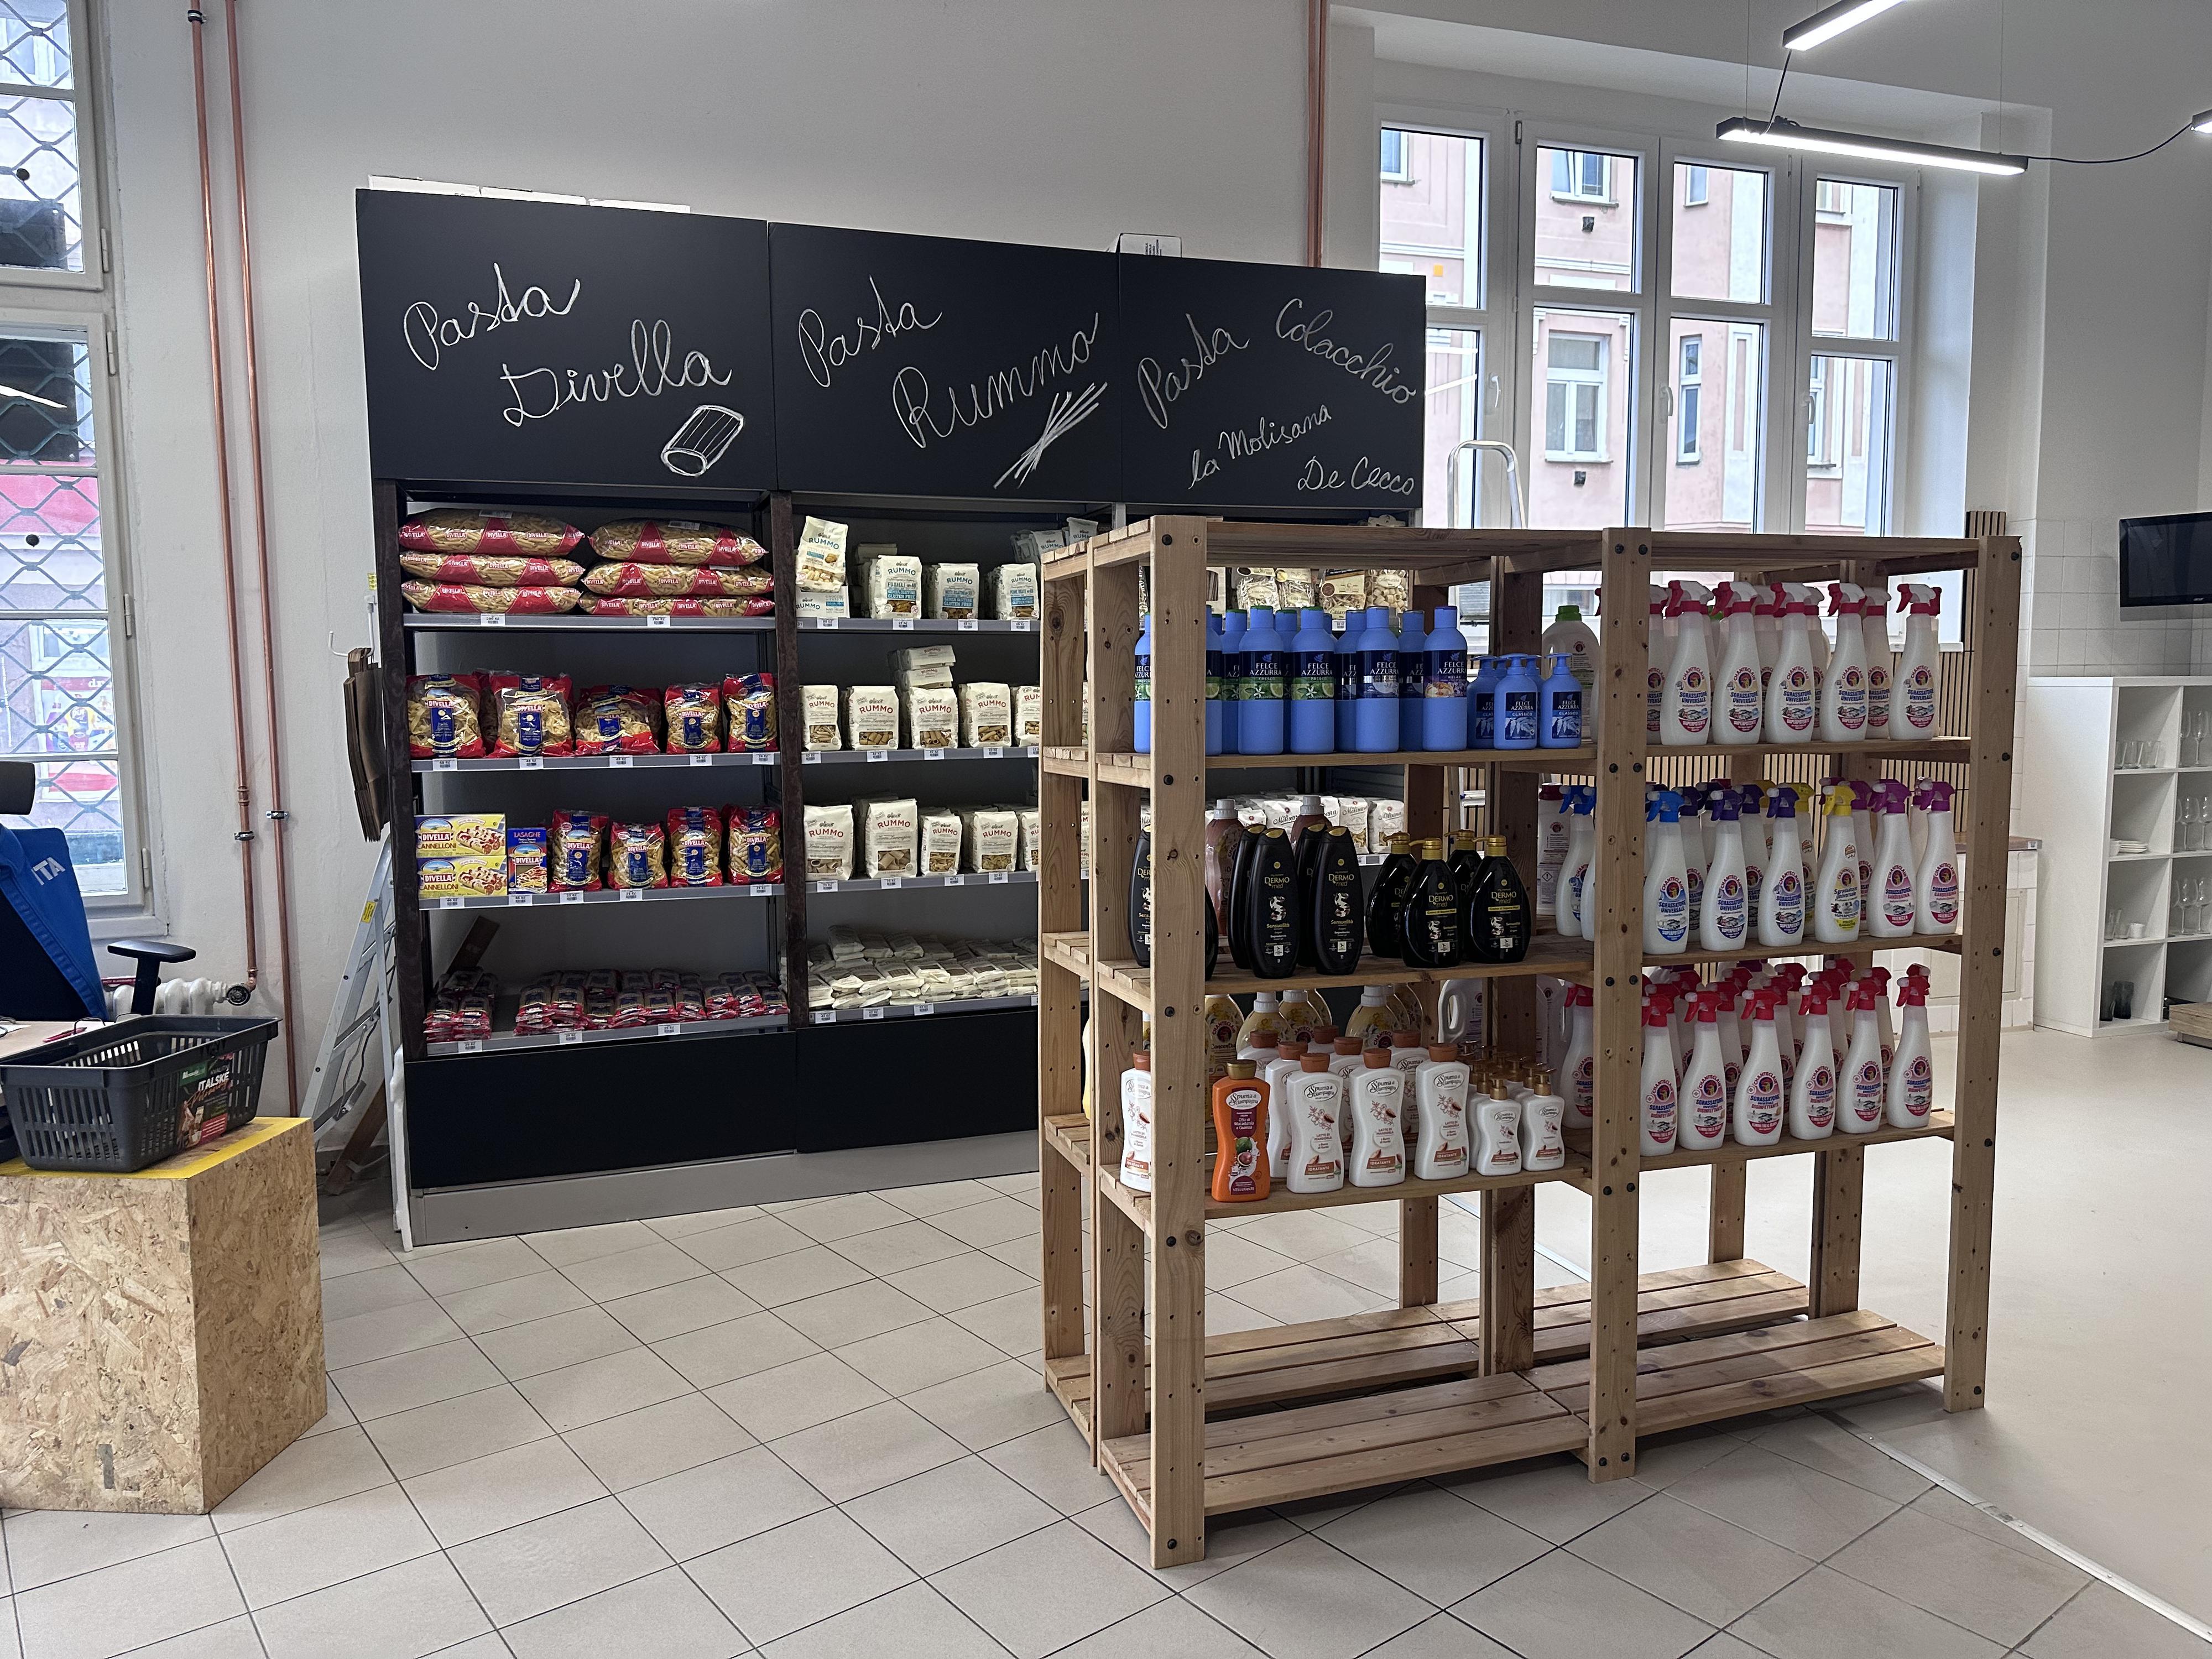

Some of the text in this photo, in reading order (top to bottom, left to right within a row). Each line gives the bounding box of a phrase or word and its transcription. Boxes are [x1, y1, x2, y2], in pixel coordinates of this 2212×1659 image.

[403, 262, 580, 371] Pasta
[799, 274, 942, 387] Pasta
[1275, 298, 1416, 404] Colacchio
[499, 319, 733, 427] Divella
[1138, 312, 1250, 429] Pasta
[893, 312, 1099, 448] Rummo
[1218, 405, 1332, 459] Molisana
[1297, 456, 1414, 495] De Cecco
[808, 538, 839, 550] RUMMO
[1683, 667, 1704, 680] CHANTECLAIR
[1733, 667, 1756, 680] CHANTECLAIR
[1787, 666, 1809, 680] CHANTECLAIR
[1841, 666, 1863, 679] CHANTECLAIR
[1911, 665, 1932, 679] CHANTECLAIR
[860, 705, 893, 714] RUMMO
[919, 705, 951, 714] RUMMO
[878, 820, 910, 829] RUMMO
[809, 829, 843, 837] RUMMO
[31, 857, 66, 885] ITA
[1888, 865, 1907, 878] CHANTECLAIR
[1934, 863, 1955, 876] CHANTECLAIR
[1662, 877, 1683, 890] CHANTECLAIR
[1721, 875, 1741, 889] CHANTECLAIR
[1779, 871, 1799, 885] CHANTECLAIR
[1212, 1021, 1235, 1035] CHANTECLAIR
[1859, 1061, 1880, 1074] CHANTECLAIR
[1910, 1056, 1929, 1070] CHANTECLAIR
[198, 1068, 229, 1091] ITALSKÉ
[1754, 1072, 1777, 1085] CHANTECLAIR
[1813, 1066, 1832, 1079] CHANTECLAIR
[1652, 1079, 1673, 1094] CHANTECLAIR
[1699, 1074, 1721, 1088] CHANTECLAIR
[1650, 1102, 1676, 1110] SGRASSATORE
